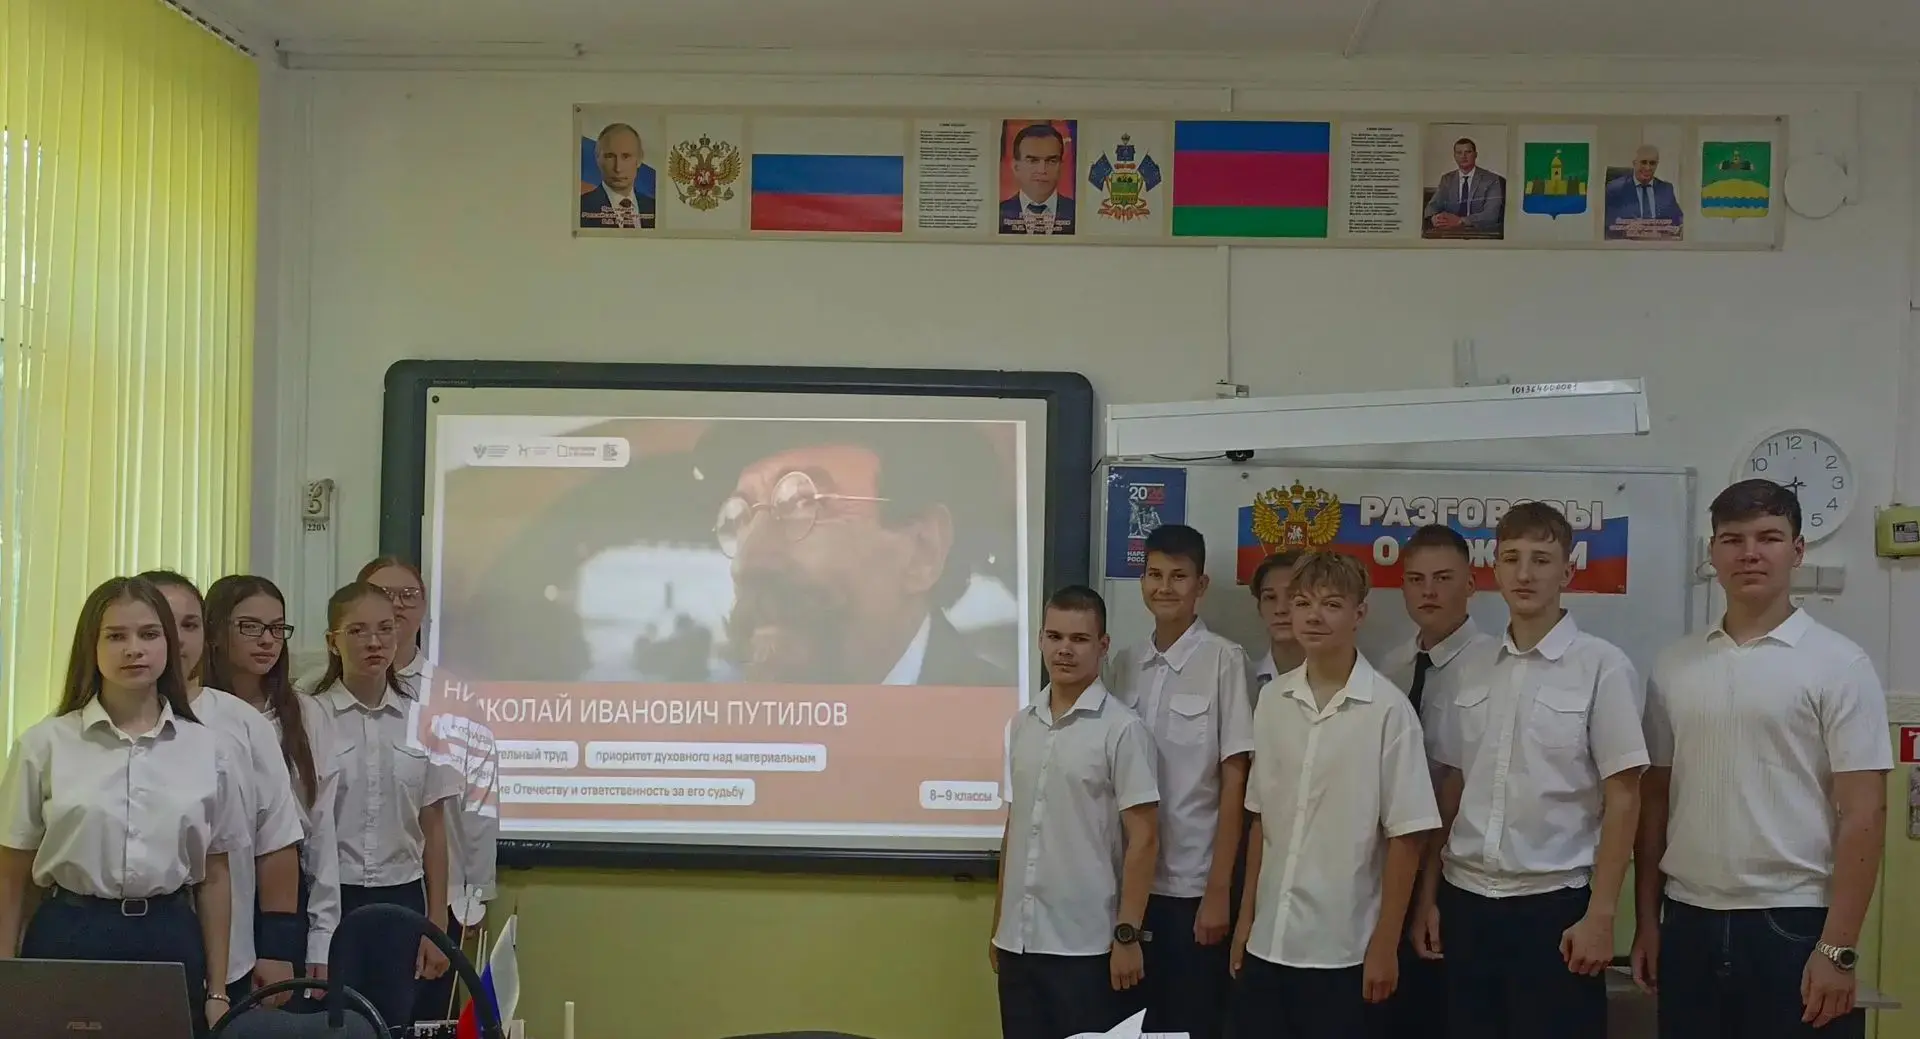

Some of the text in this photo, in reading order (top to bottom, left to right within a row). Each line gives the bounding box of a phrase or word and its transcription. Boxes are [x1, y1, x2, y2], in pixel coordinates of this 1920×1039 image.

[1767, 442, 1779, 456] 11
[1786, 435, 1802, 450] 12
[1812, 440, 1818, 454] 1
[1751, 457, 1768, 472] 10
[1825, 455, 1838, 470] 2
[1832, 476, 1844, 490] 3
[1826, 497, 1838, 511] 4
[1360, 496, 1603, 532] РАЗГОВЫ
[1810, 513, 1824, 527] 5
[1373, 535, 1399, 566] О
[580, 699, 718, 725] ИВАНОВИЧ
[727, 700, 848, 727] ПУТИЛОВ
[543, 750, 569, 763] труд
[596, 751, 816, 766] приоритет духовного над материальным
[513, 783, 568, 798] Отечеству
[570, 786, 578, 795] и
[580, 786, 670, 797] ответственность
[672, 787, 685, 797] за
[687, 788, 705, 798] его
[707, 785, 745, 799] судьбу
